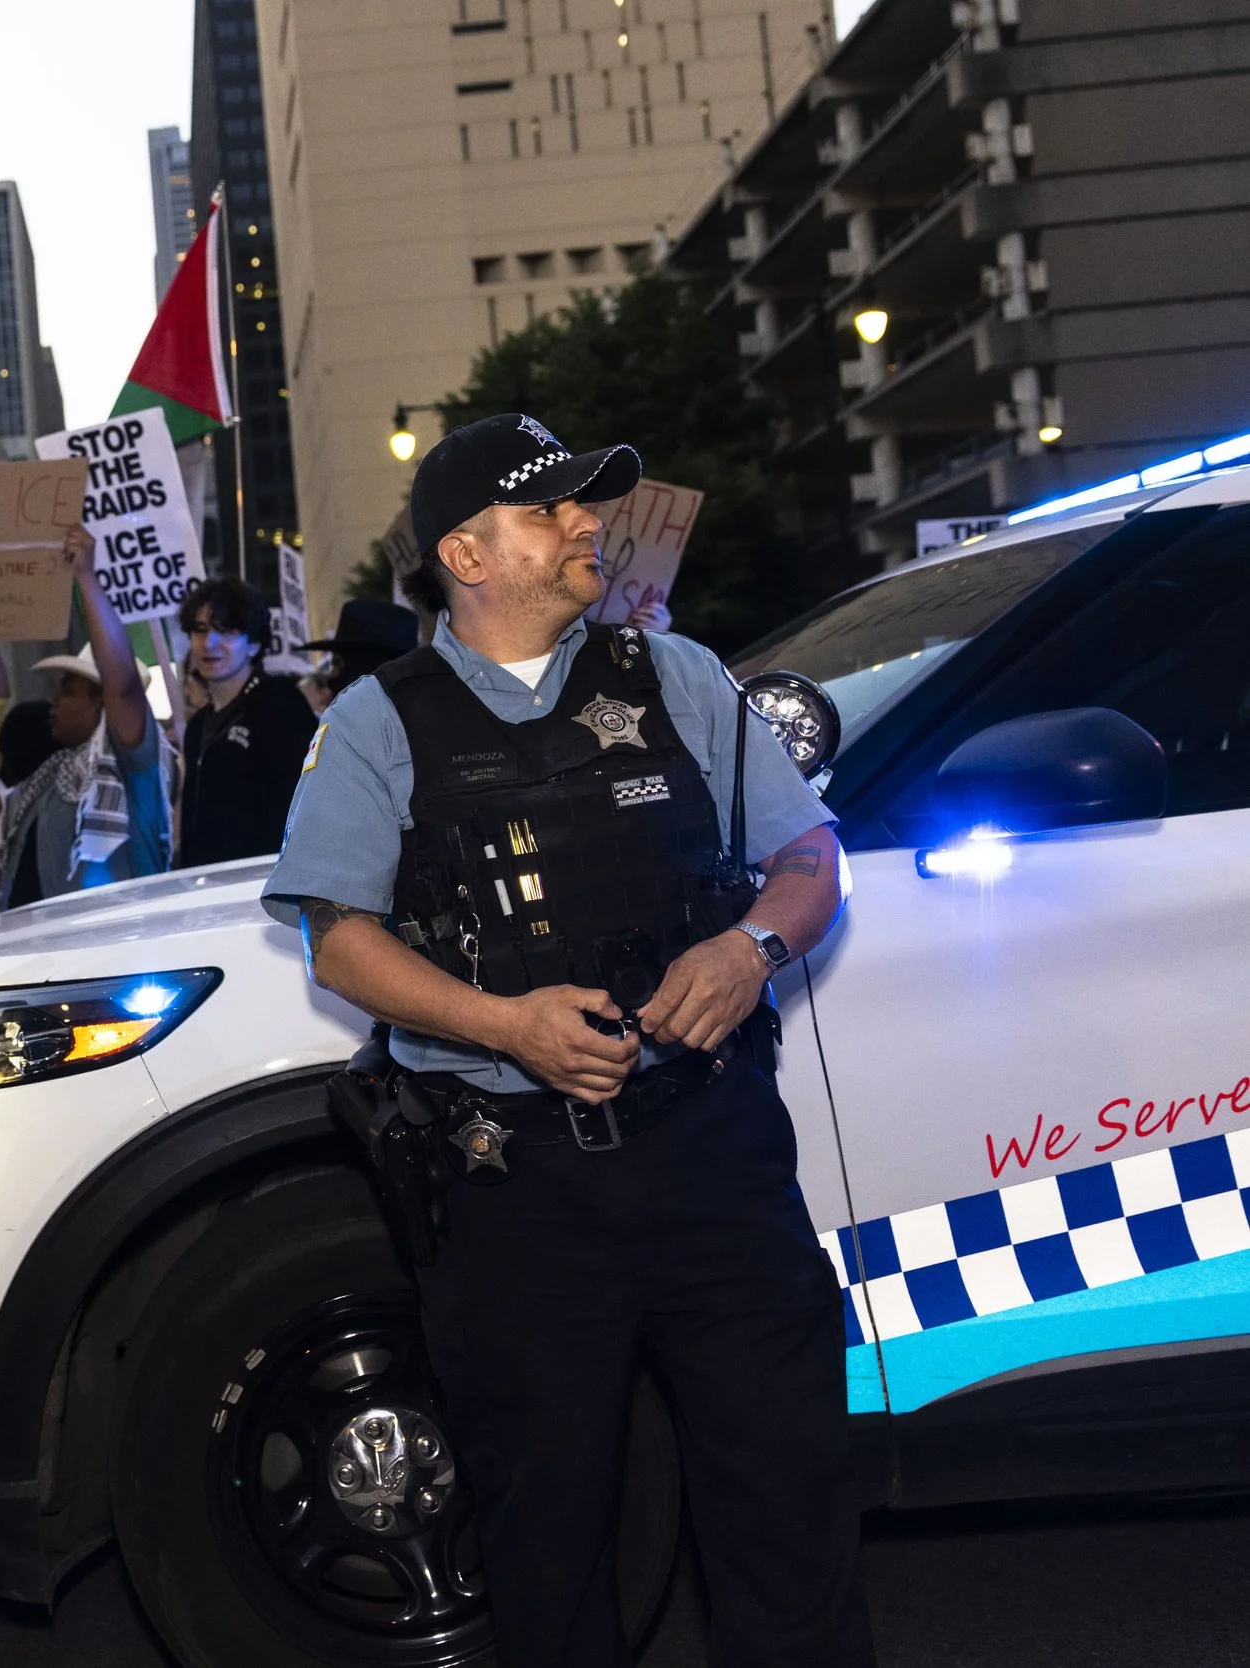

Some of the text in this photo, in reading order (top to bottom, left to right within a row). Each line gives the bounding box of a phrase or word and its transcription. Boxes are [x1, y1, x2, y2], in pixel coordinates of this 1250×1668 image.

[67, 419, 144, 458] STOP
[88, 453, 145, 489] THE
[14, 474, 92, 528] ICE
[82, 479, 167, 523] RAIDS
[104, 525, 161, 563] ICE
[95, 552, 187, 593] OUT OF
[106, 576, 201, 615] HICAGO
[589, 705, 636, 728] CHICAGO POLICE
[452, 752, 506, 764] MENDOZA
[644, 775, 666, 785] POLICE
[986, 1076, 1250, 1179] We Serve
